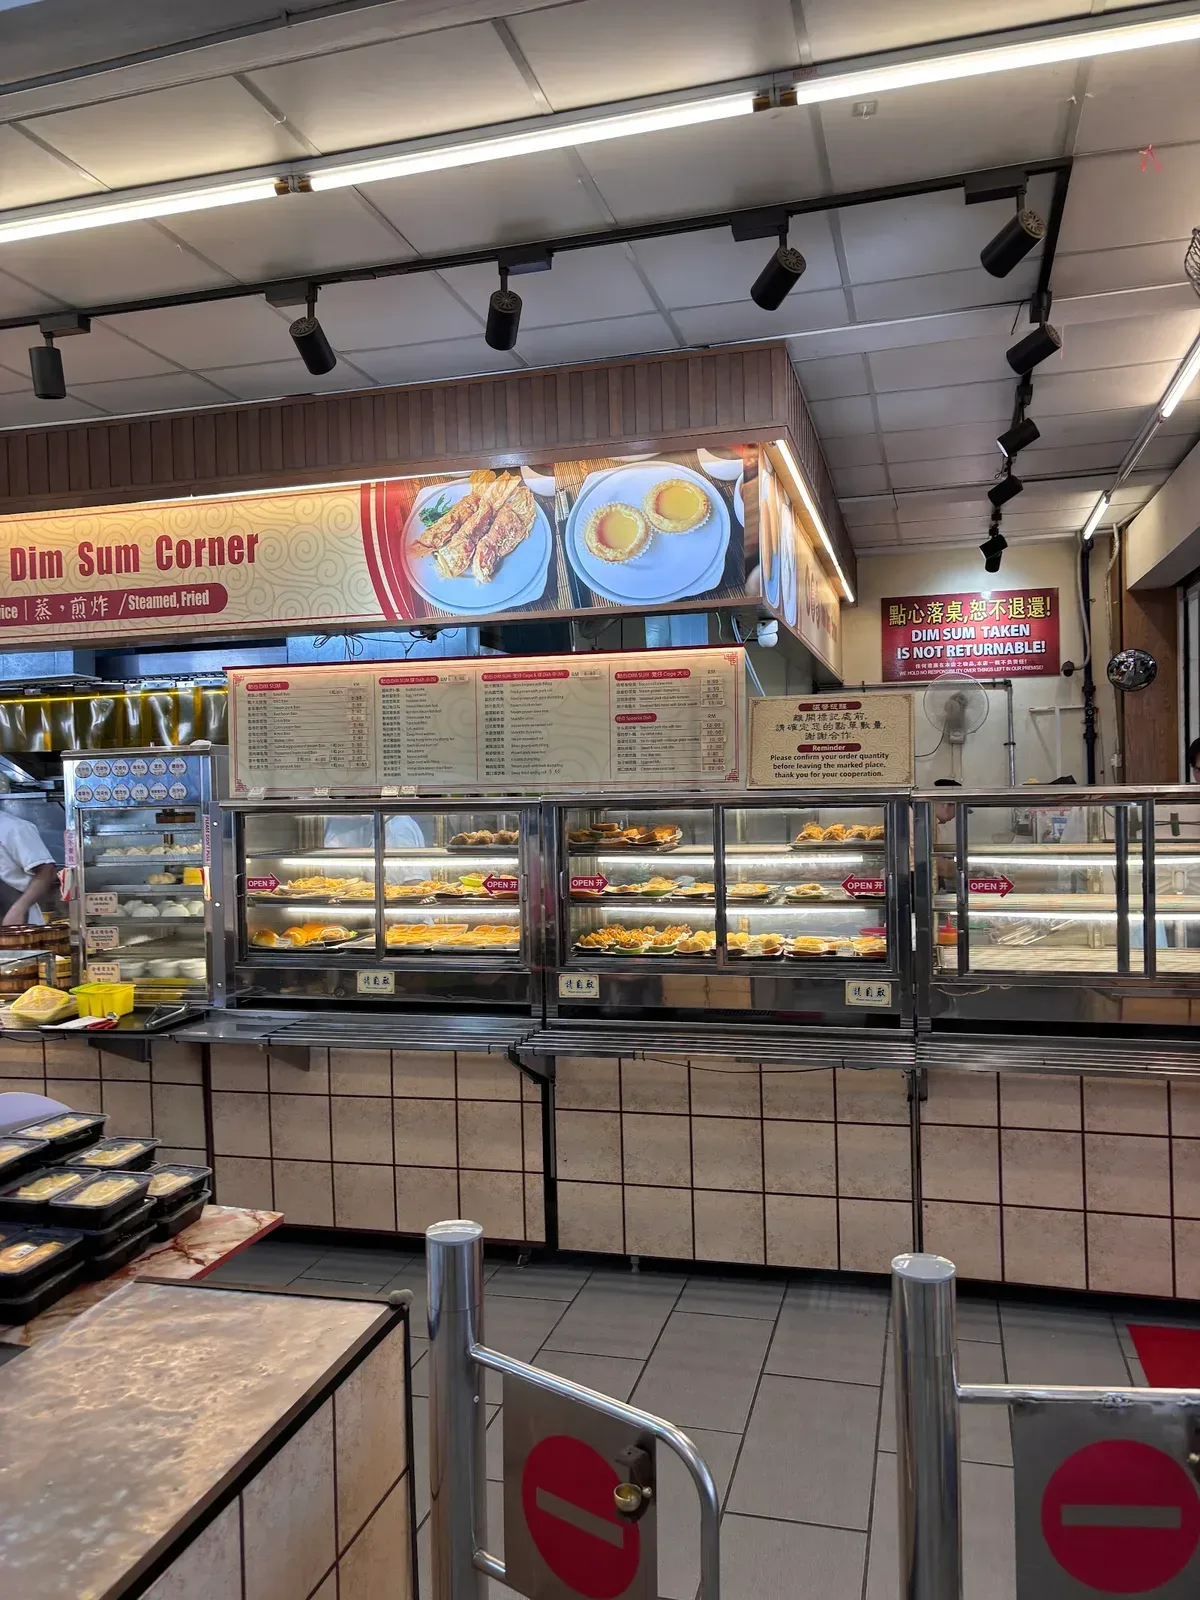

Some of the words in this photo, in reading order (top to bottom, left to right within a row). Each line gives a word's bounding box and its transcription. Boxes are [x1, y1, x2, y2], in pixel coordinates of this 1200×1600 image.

[10, 546, 63, 581] Dim
[78, 541, 140, 577] Sum
[155, 532, 259, 571] Corner
[181, 589, 209, 607] Fried
[889, 597, 1051, 626] 點心落桌,恕不退還!
[911, 628, 940, 642] DIM
[942, 626, 975, 641] SUM
[981, 624, 1030, 639] TAKEN
[897, 647, 911, 660] IS
[913, 645, 943, 659] NOT
[946, 640, 1046, 658] RETURNABLE!
[812, 744, 846, 752] Reminder
[793, 753, 820, 761] confirm
[821, 754, 837, 762] your
[858, 752, 889, 760] quantity
[772, 762, 795, 770] before
[796, 762, 822, 771] leaving
[836, 761, 863, 769] marked
[795, 772, 809, 780] you
[810, 770, 820, 778] for
[839, 770, 884, 778] cooperation.
[572, 879, 595, 887] OPEN
[847, 881, 873, 890] OPEN
[970, 882, 997, 890] OPEN
